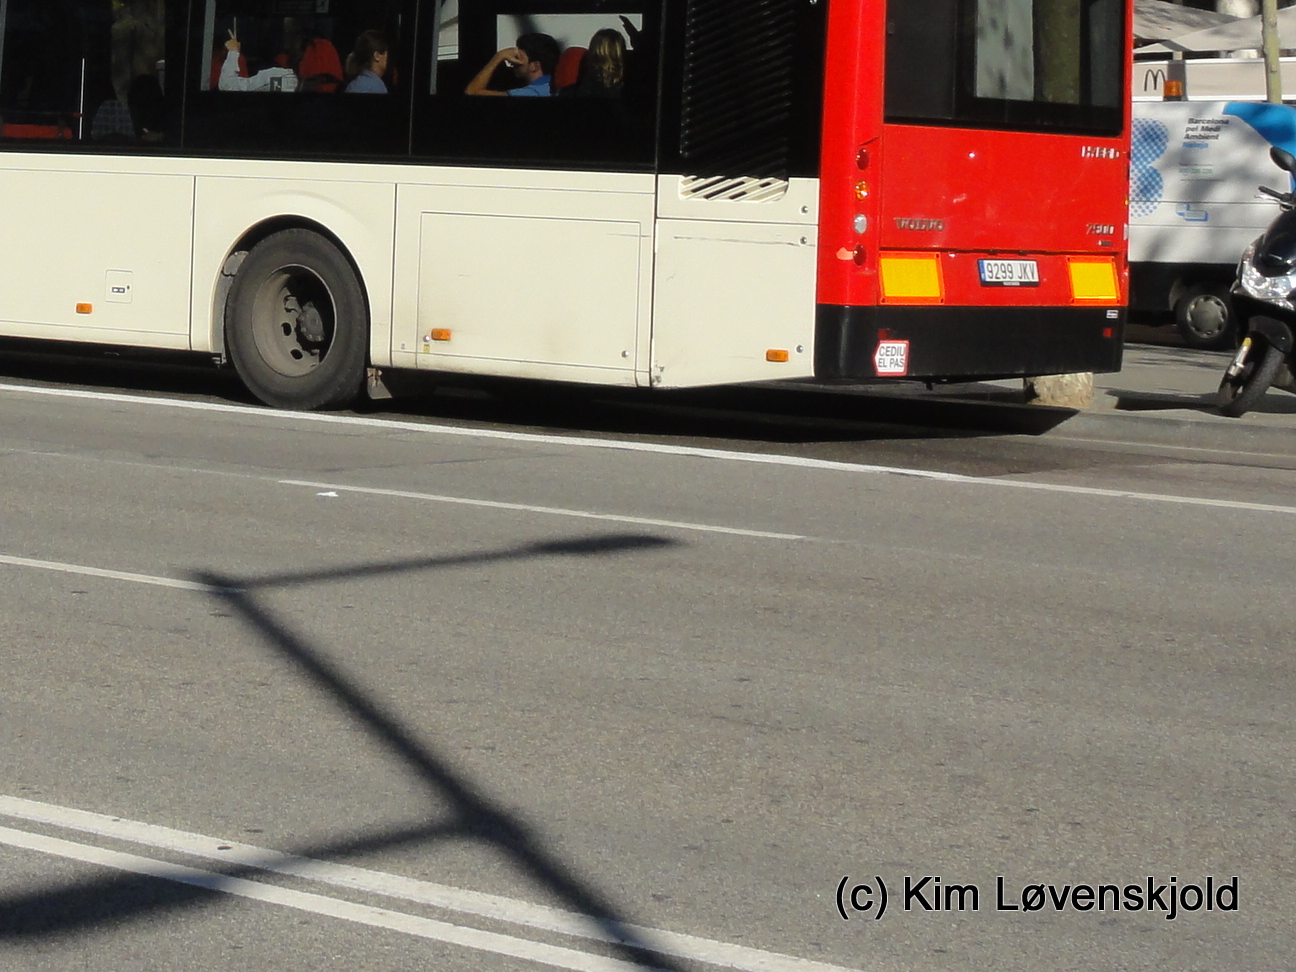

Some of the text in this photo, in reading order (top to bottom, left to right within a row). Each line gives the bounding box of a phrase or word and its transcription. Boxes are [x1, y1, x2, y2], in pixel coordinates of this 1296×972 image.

[1188, 117, 1229, 125] Barcelona
[986, 262, 1035, 280] 9299 JKV
[879, 346, 905, 356] CEDIU
[878, 357, 904, 368] EL PAS
